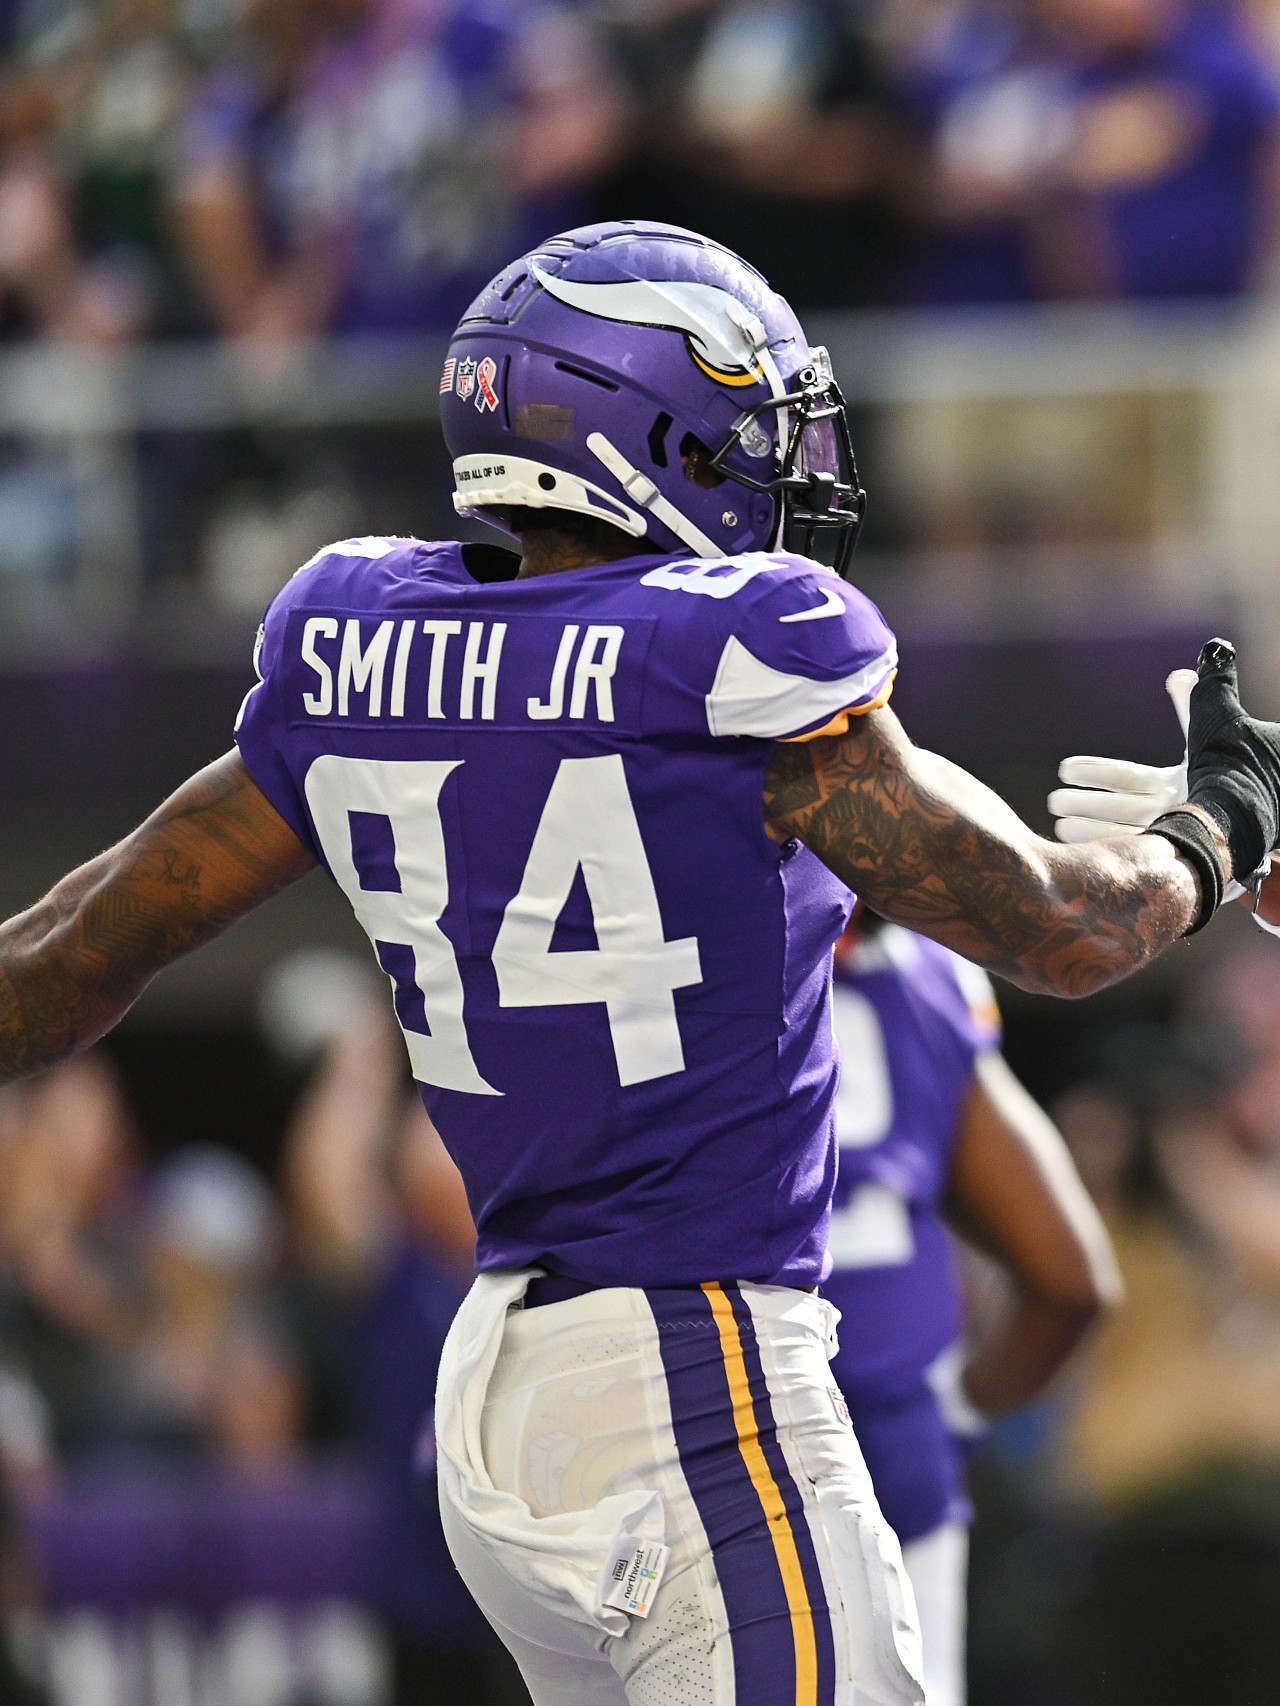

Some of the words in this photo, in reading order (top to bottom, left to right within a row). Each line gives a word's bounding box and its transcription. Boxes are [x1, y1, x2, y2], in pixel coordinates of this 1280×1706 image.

[472, 469, 483, 479] ALL
[483, 467, 492, 477] OF
[494, 465, 505, 475] US
[302, 617, 507, 720] SMITH
[527, 625, 624, 722] JR
[304, 754, 703, 1096] 84
[624, 1549, 644, 1599] northwest
